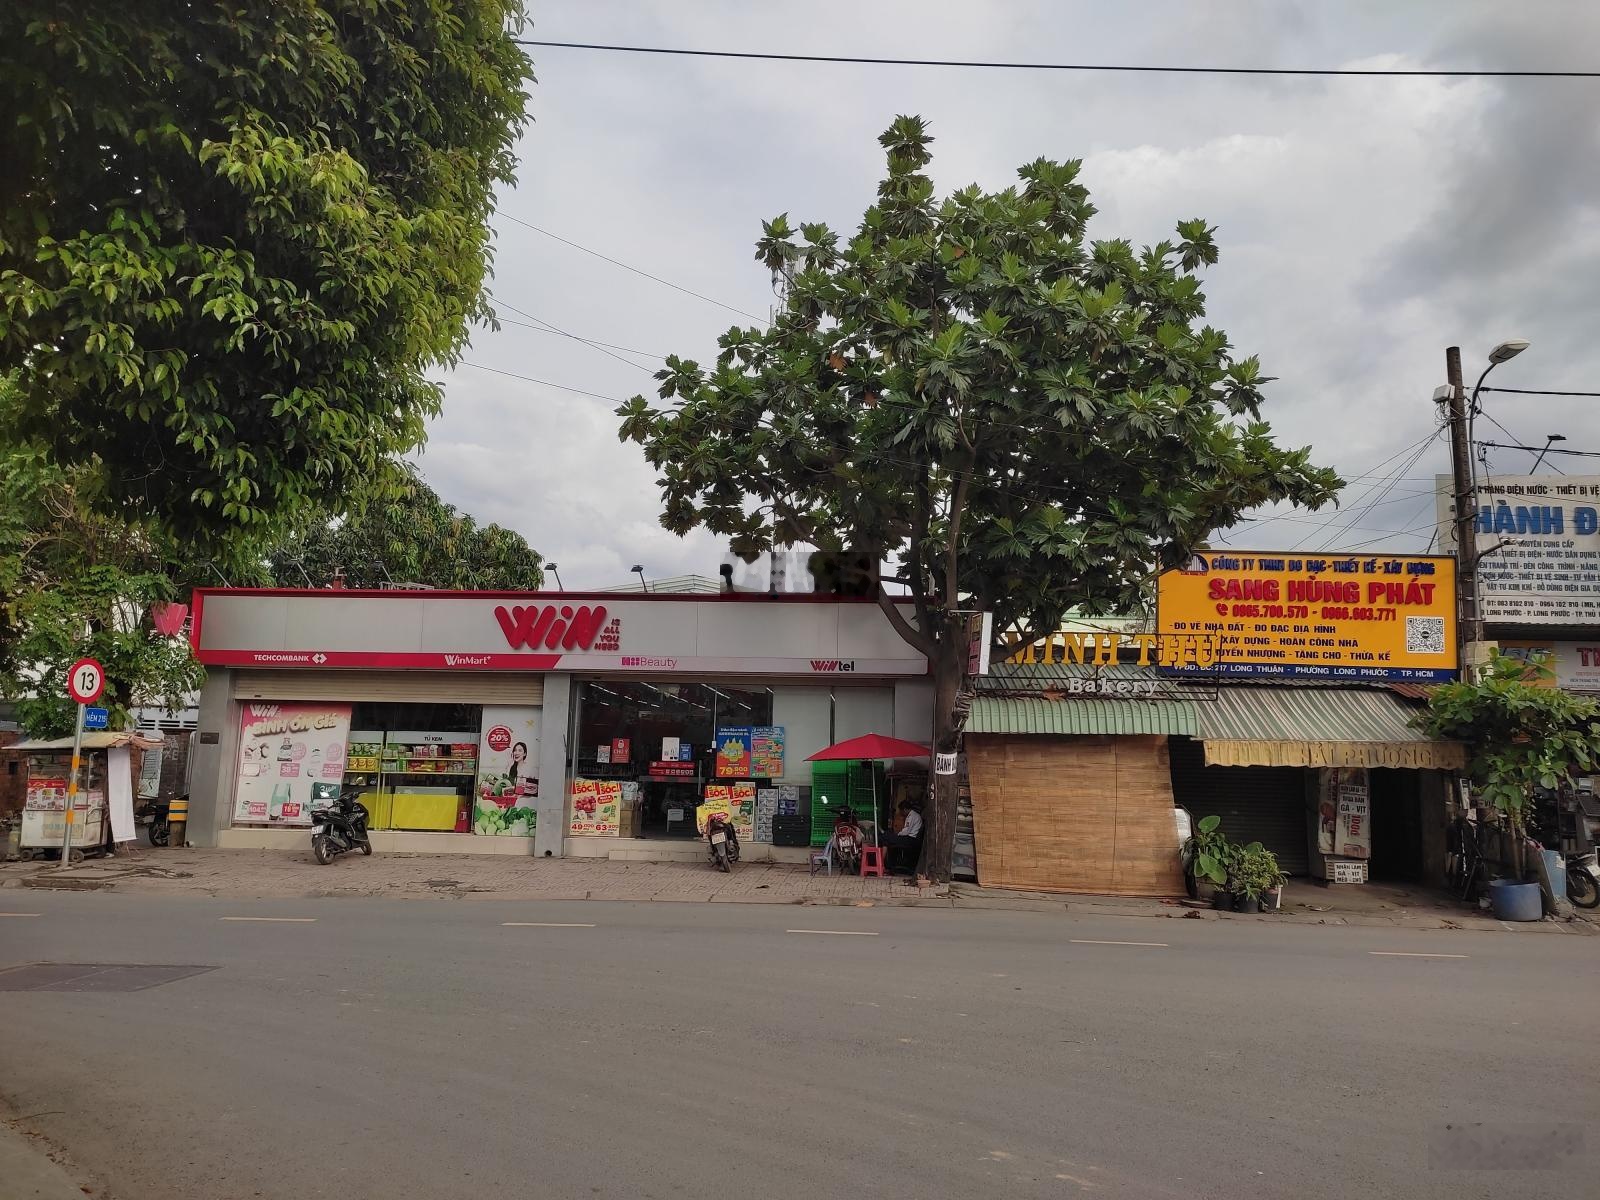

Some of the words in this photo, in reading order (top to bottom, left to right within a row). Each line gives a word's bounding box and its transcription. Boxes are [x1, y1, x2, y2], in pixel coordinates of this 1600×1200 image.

[1527, 484, 1547, 494] NƯỚC
[1556, 484, 1577, 495] THIẾT
[1472, 500, 1564, 535] HÀNH
[1574, 506, 1600, 535] Đ
[1242, 558, 1255, 571] TY
[1209, 577, 1280, 601] SANG
[1288, 575, 1360, 603] HÙNG
[1368, 577, 1436, 605] PHÁT
[611, 618, 620, 626] IS
[603, 626, 620, 634] ALL
[600, 634, 620, 643] YOU
[594, 642, 620, 651] NEED
[1005, 632, 1121, 666] MINH
[254, 654, 309, 662] TECHCOMBANK
[1322, 651, 1342, 660] CHO
[640, 657, 678, 668] Beauty
[1230, 664, 1253, 672] LONG
[1334, 668, 1357, 676] LONG
[1401, 669, 1413, 677] TP.
[1415, 669, 1434, 678] HCM
[81, 671, 95, 691] 13
[1067, 677, 1160, 696] Bakery
[490, 733, 509, 742] 20%
[1340, 802, 1350, 812] GÀ
